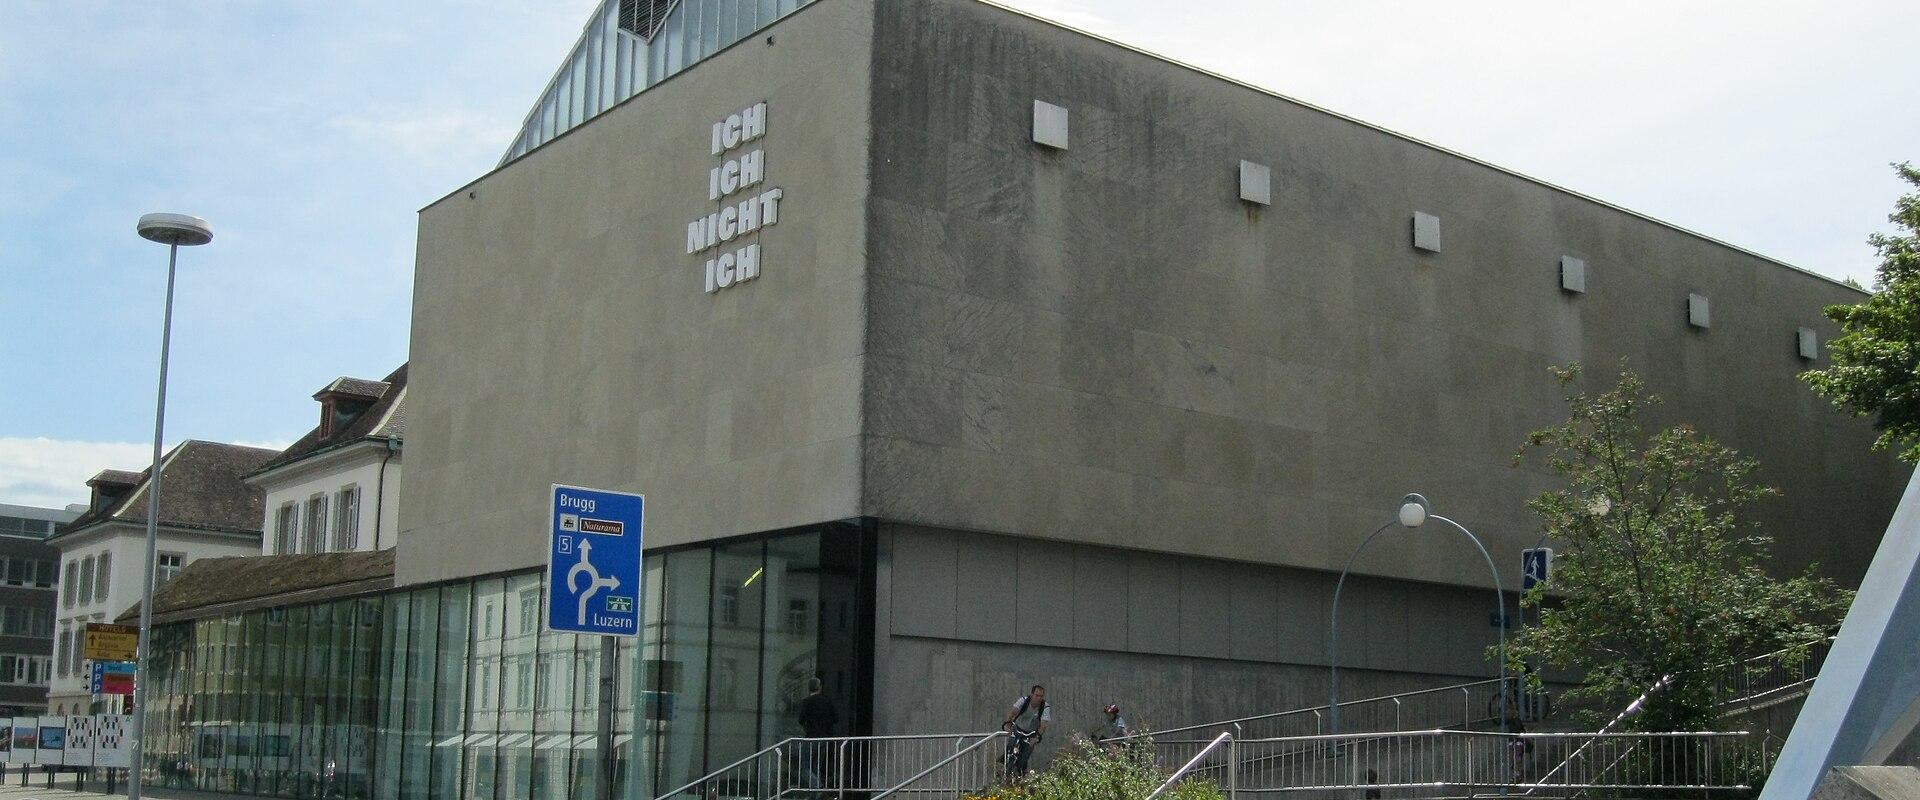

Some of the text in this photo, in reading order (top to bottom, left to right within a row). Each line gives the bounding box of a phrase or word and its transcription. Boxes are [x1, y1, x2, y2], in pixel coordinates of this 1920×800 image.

[711, 102, 767, 156] ICH
[709, 149, 764, 201] ICH
[687, 187, 783, 254] NICHT
[705, 243, 760, 293] ICH
[560, 493, 596, 513] Brugg
[561, 538, 569, 551] 5
[582, 520, 621, 534] Naturama
[593, 613, 633, 628] Luzern
